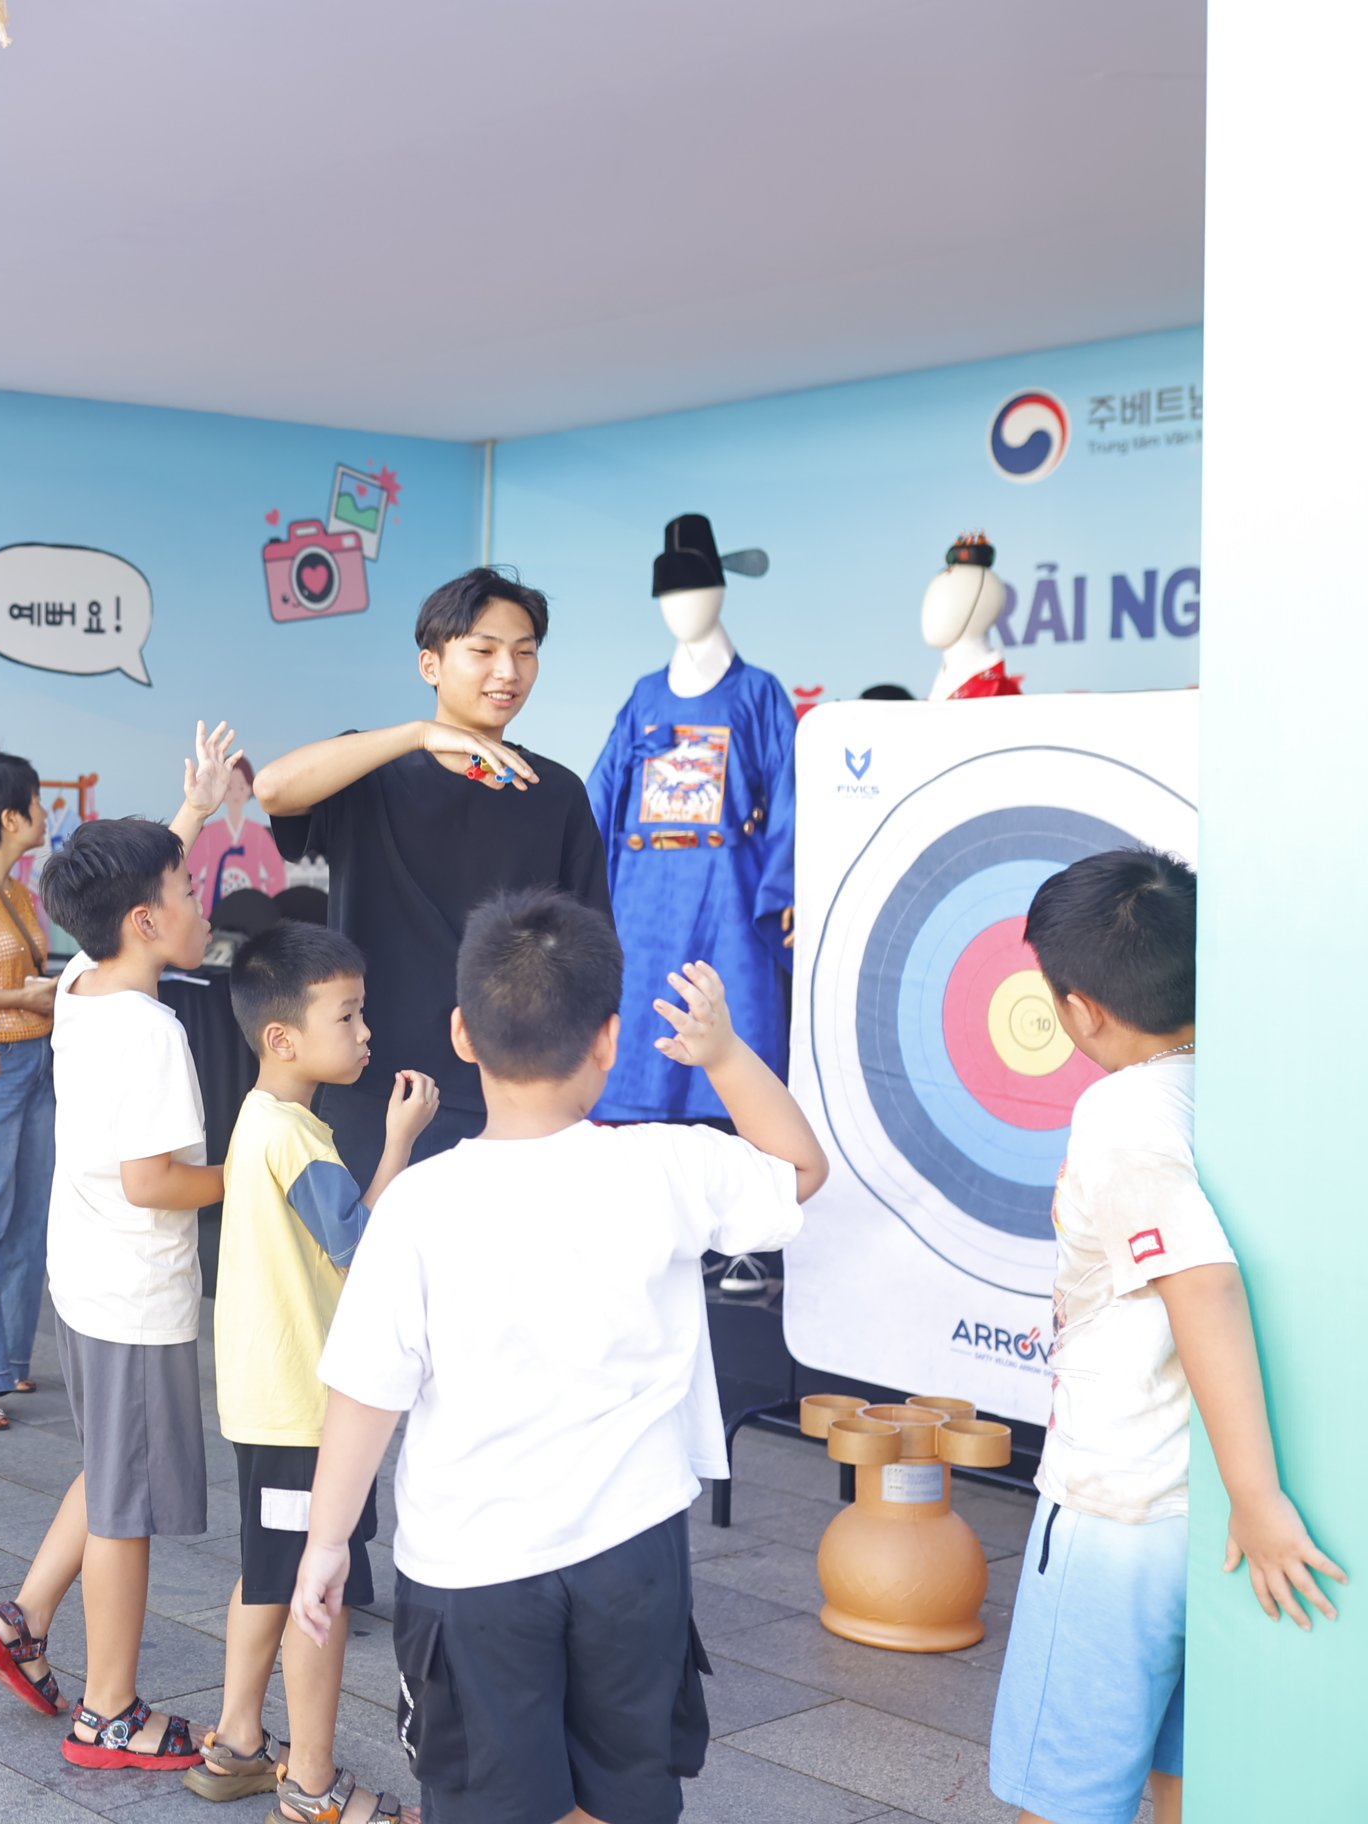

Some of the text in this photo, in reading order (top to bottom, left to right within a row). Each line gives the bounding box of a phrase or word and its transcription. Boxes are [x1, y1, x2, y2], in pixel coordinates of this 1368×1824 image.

[992, 563, 1201, 646] RẢI NG
[837, 785, 880, 795] FIVICS
[1035, 1017, 1052, 1032] 10
